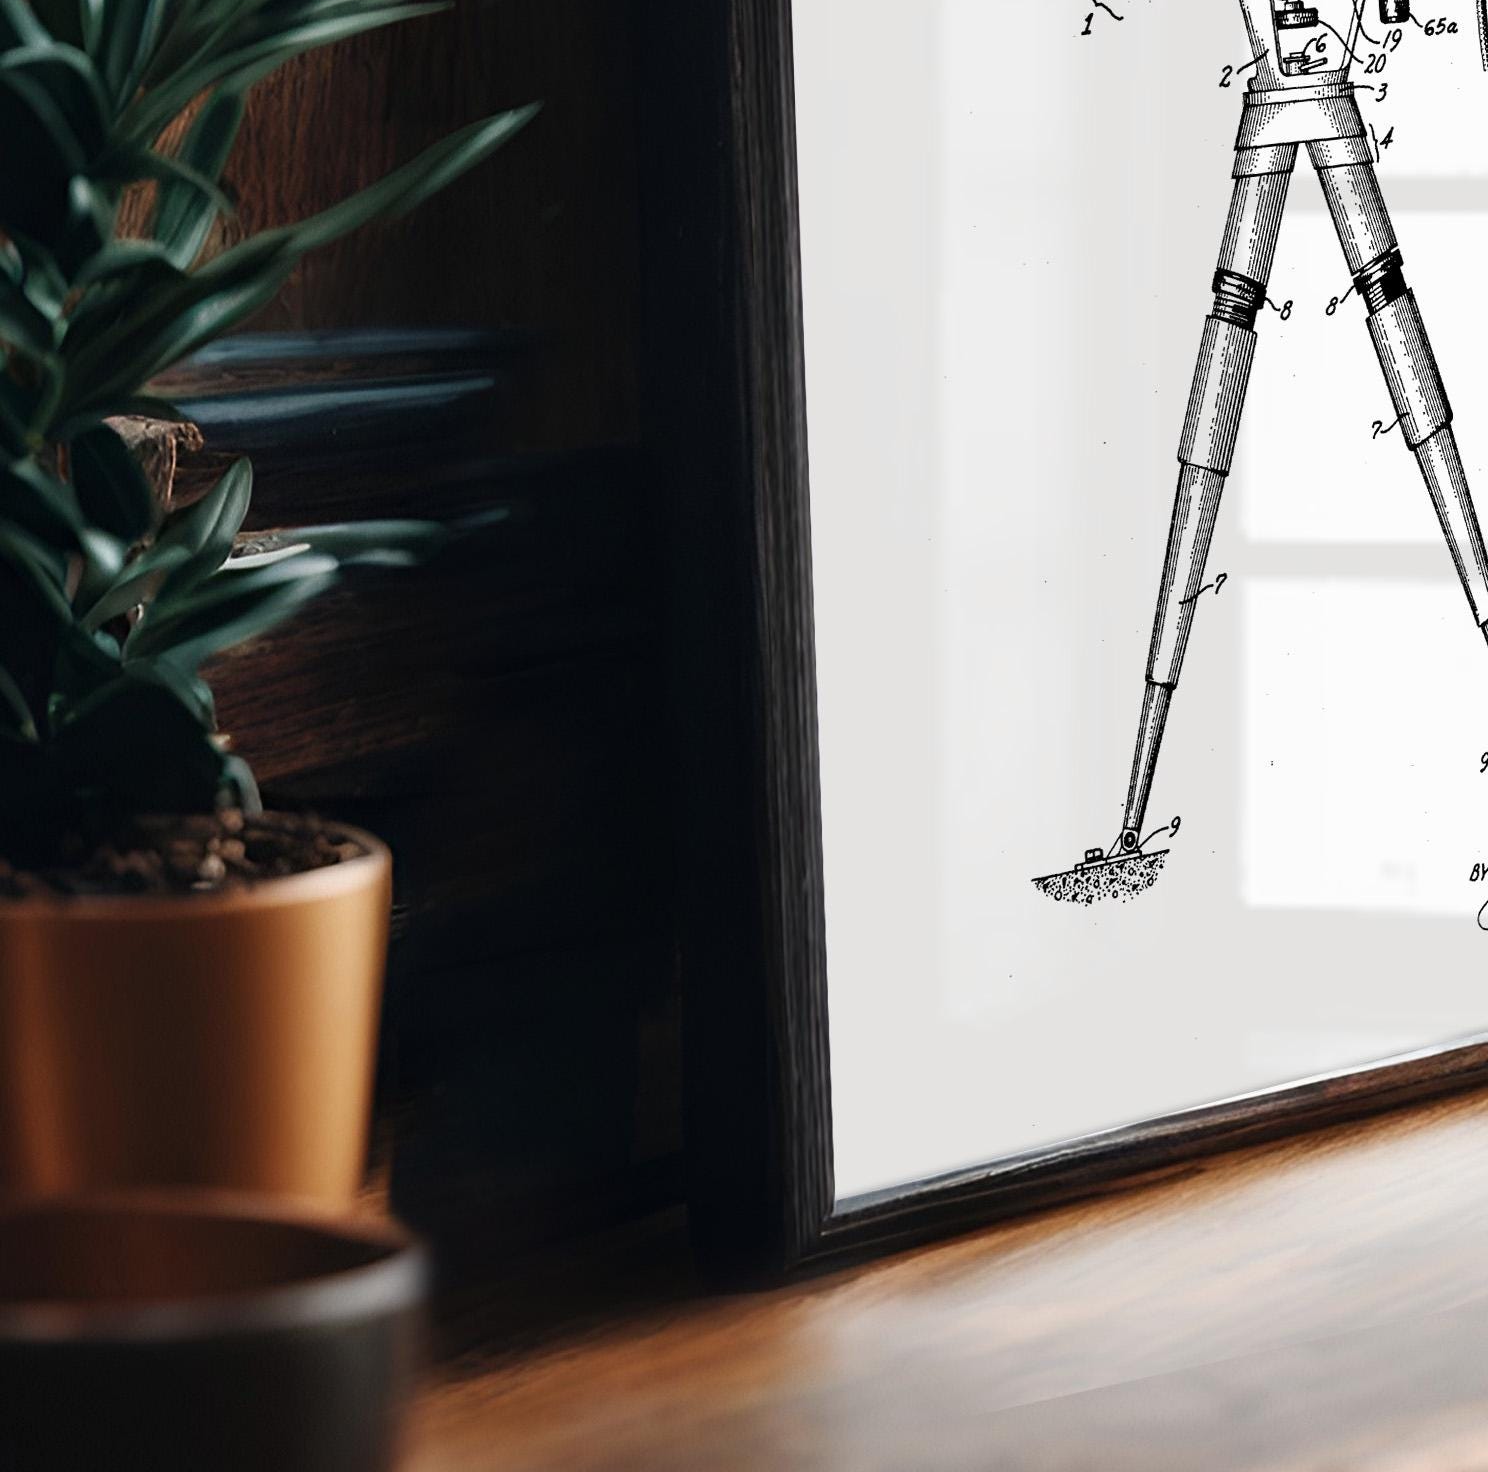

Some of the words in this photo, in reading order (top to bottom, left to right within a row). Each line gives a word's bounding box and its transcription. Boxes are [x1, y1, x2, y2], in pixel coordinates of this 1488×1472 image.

[1081, 13, 1093, 35] 1
[1316, 33, 1328, 52] 6
[1382, 30, 1402, 53] 19
[1364, 54, 1387, 74] 20
[1219, 66, 1234, 88] 2
[1375, 83, 1389, 102] 3
[1380, 126, 1395, 149] 4
[1279, 300, 1293, 320] 8
[1326, 296, 1340, 316] 8
[1169, 816, 1182, 838] 9
